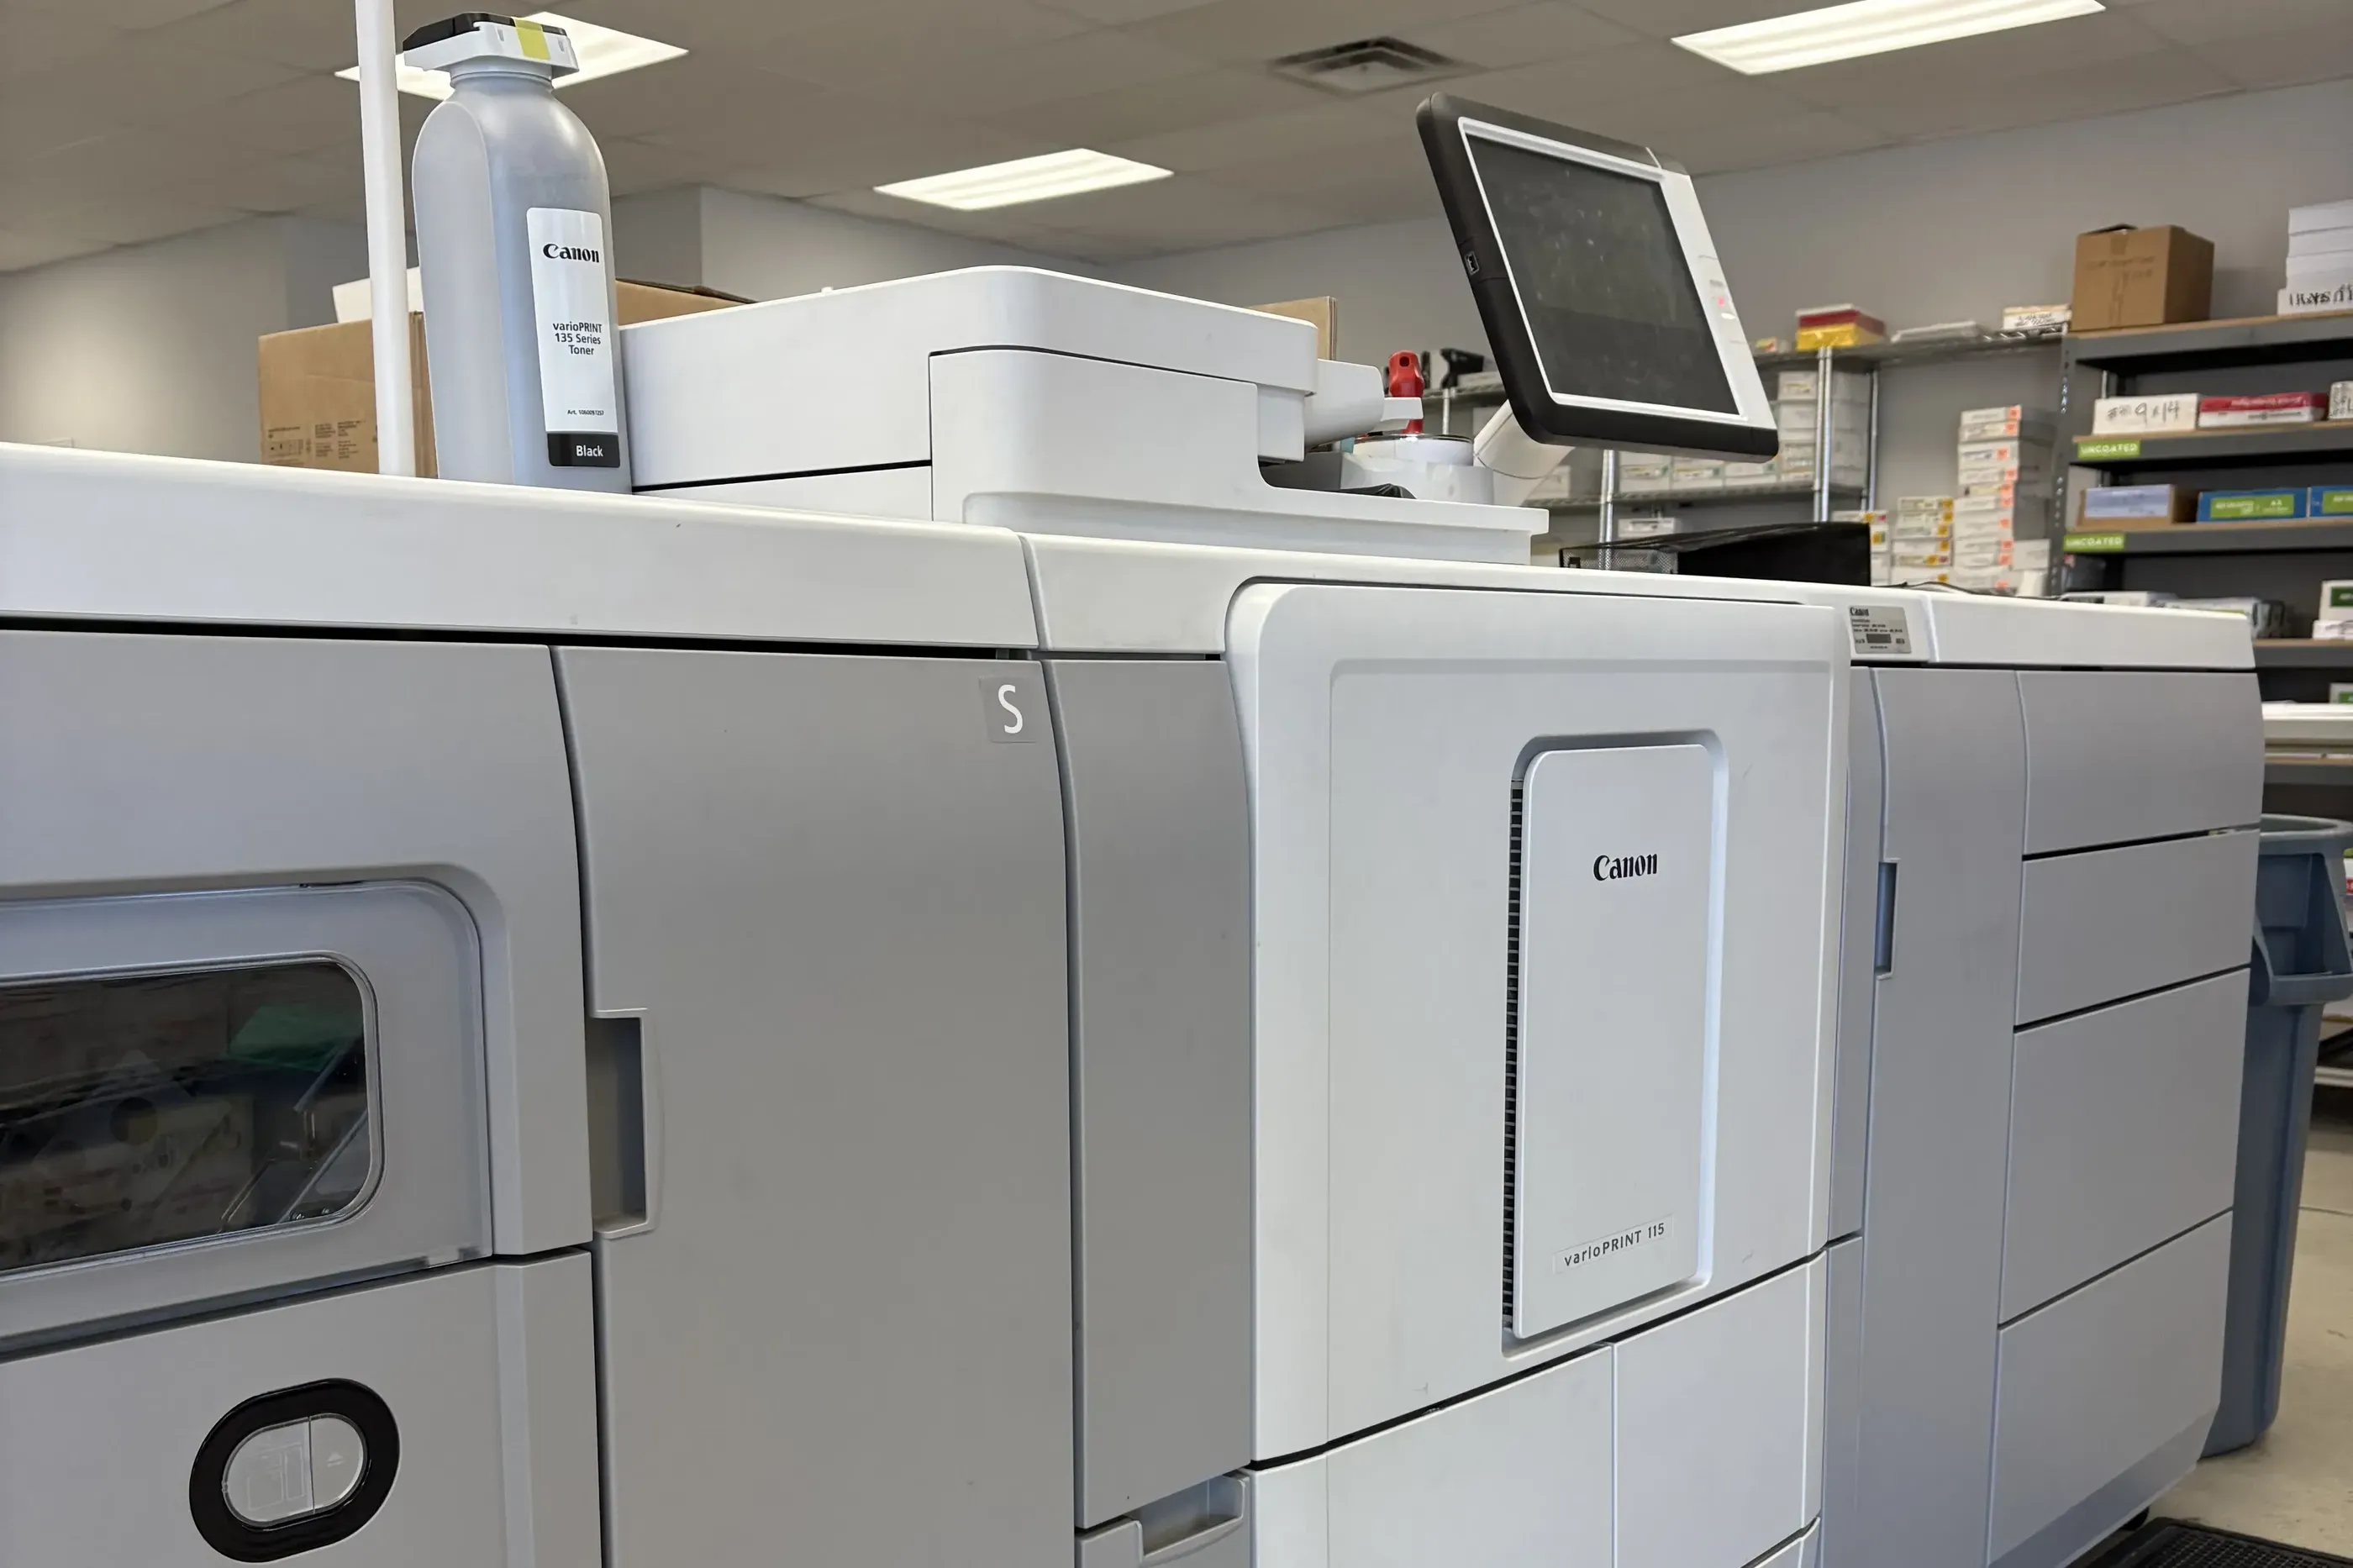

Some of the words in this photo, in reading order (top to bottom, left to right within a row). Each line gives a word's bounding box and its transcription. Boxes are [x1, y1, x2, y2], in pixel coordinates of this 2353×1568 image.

[542, 243, 600, 263] Canon
[552, 320, 603, 334] varioPRINT
[555, 332, 573, 343] 135
[576, 333, 602, 345] Series
[568, 344, 594, 355] Toner
[576, 445, 604, 457] Black
[2080, 442, 2139, 455] UNCOATED
[998, 684, 1024, 734] S
[1592, 853, 1658, 881] Canon
[1564, 1229, 1642, 1267] varioPRINT
[1647, 1222, 1666, 1239] 115
